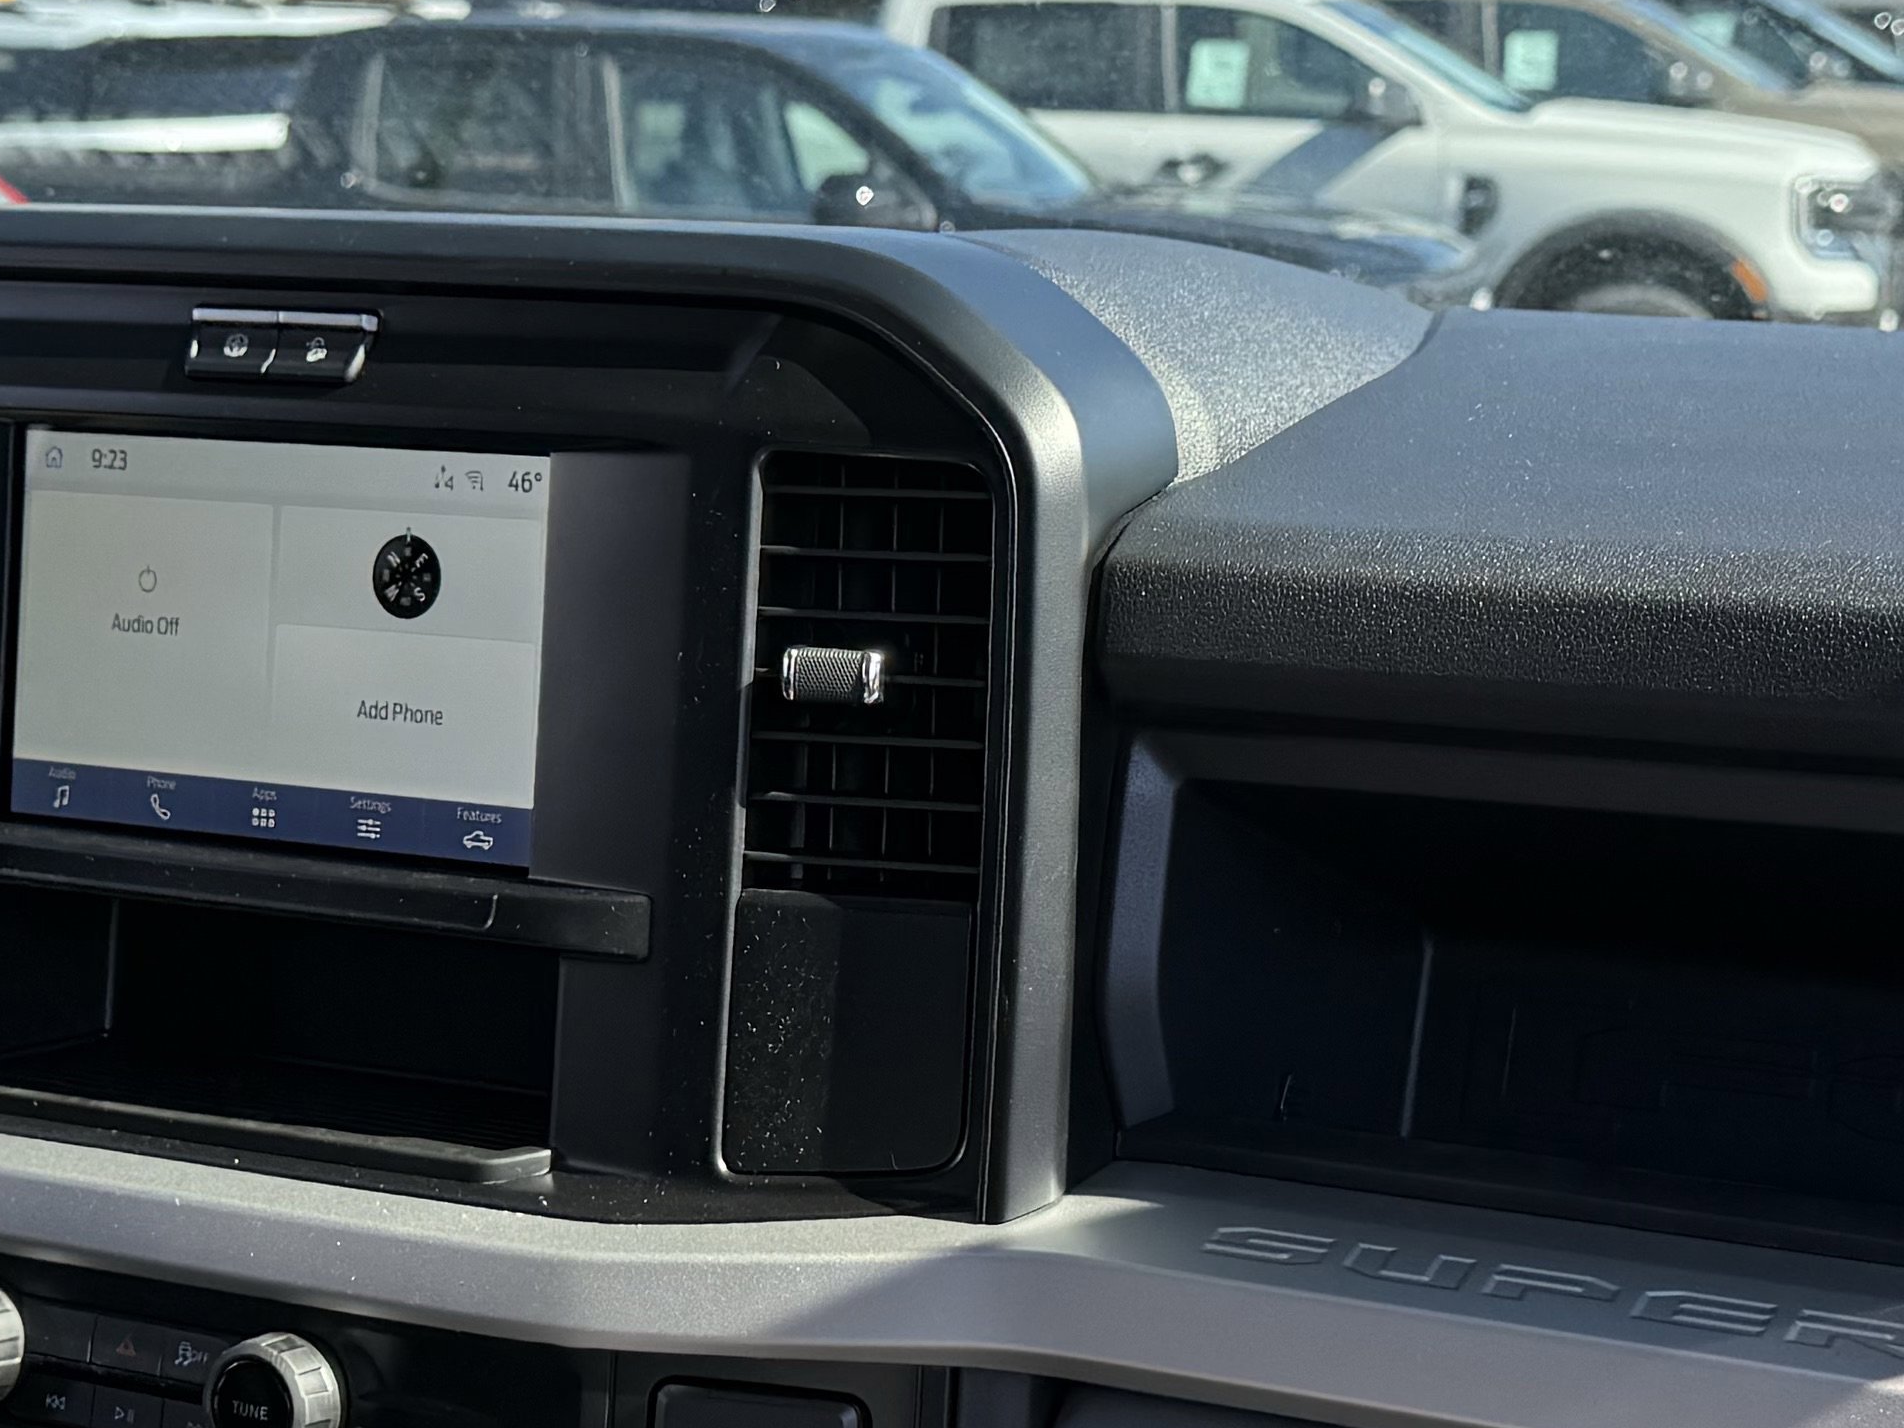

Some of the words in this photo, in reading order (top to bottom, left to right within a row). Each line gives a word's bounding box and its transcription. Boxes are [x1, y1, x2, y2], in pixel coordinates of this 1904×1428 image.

[91, 448, 128, 471] 9:23
[413, 586, 426, 602] S
[111, 613, 154, 634] Audio
[157, 616, 179, 636] Off
[356, 700, 388, 721] Add
[391, 702, 444, 726] Phone
[146, 775, 177, 790] Phone
[456, 806, 502, 824] Features
[232, 1399, 269, 1421] TUNE
